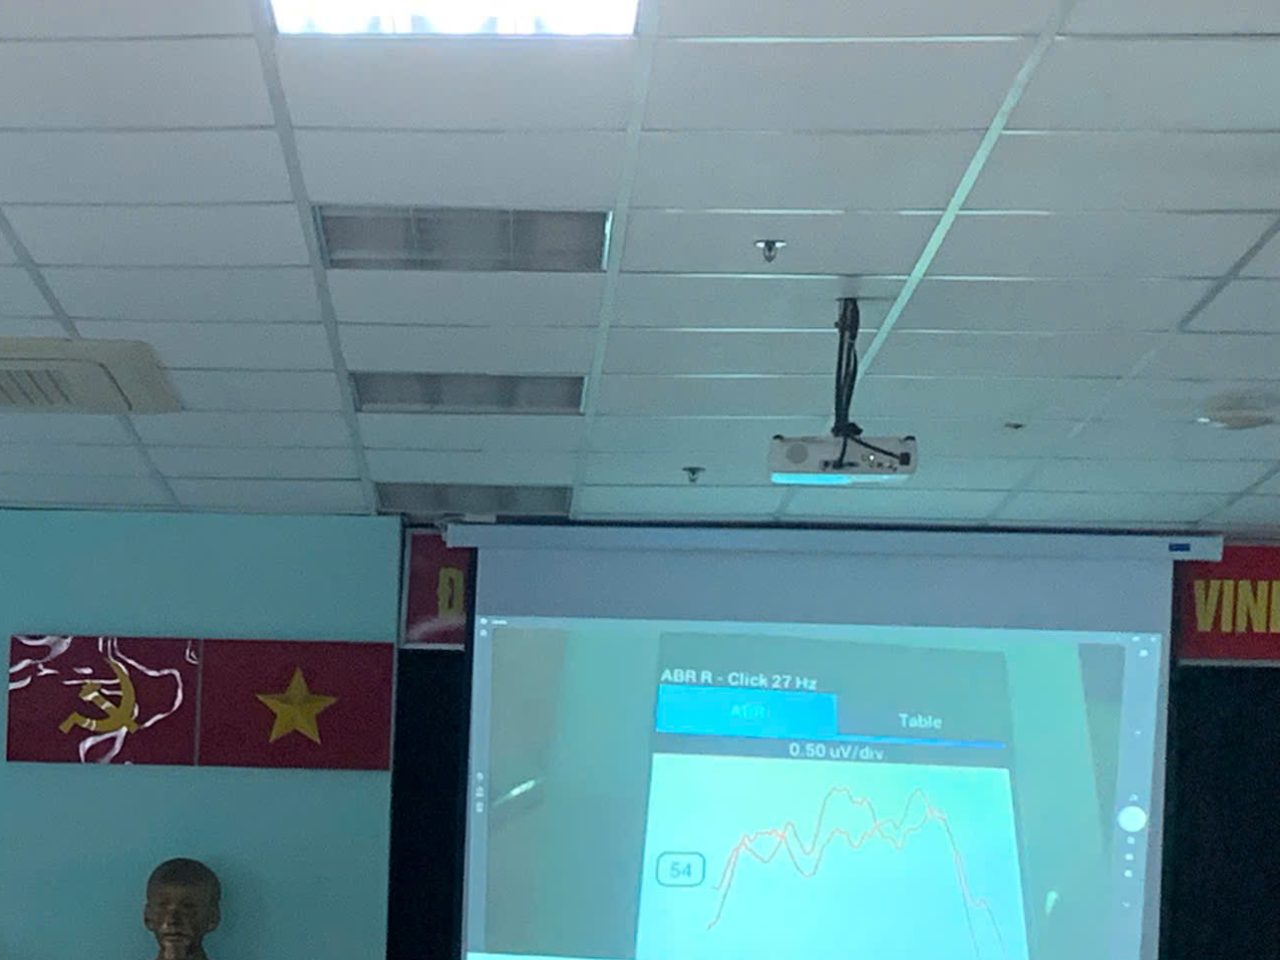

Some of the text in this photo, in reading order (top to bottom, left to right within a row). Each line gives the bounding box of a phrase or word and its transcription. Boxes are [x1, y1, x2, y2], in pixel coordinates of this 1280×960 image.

[661, 669, 697, 684] ABR
[701, 670, 713, 684] R
[728, 672, 768, 688] Click
[772, 675, 793, 689] 27
[796, 677, 818, 690] Hz
[898, 713, 943, 729] Table
[789, 742, 884, 760] 0.50 uV/div
[670, 860, 692, 879] 54
